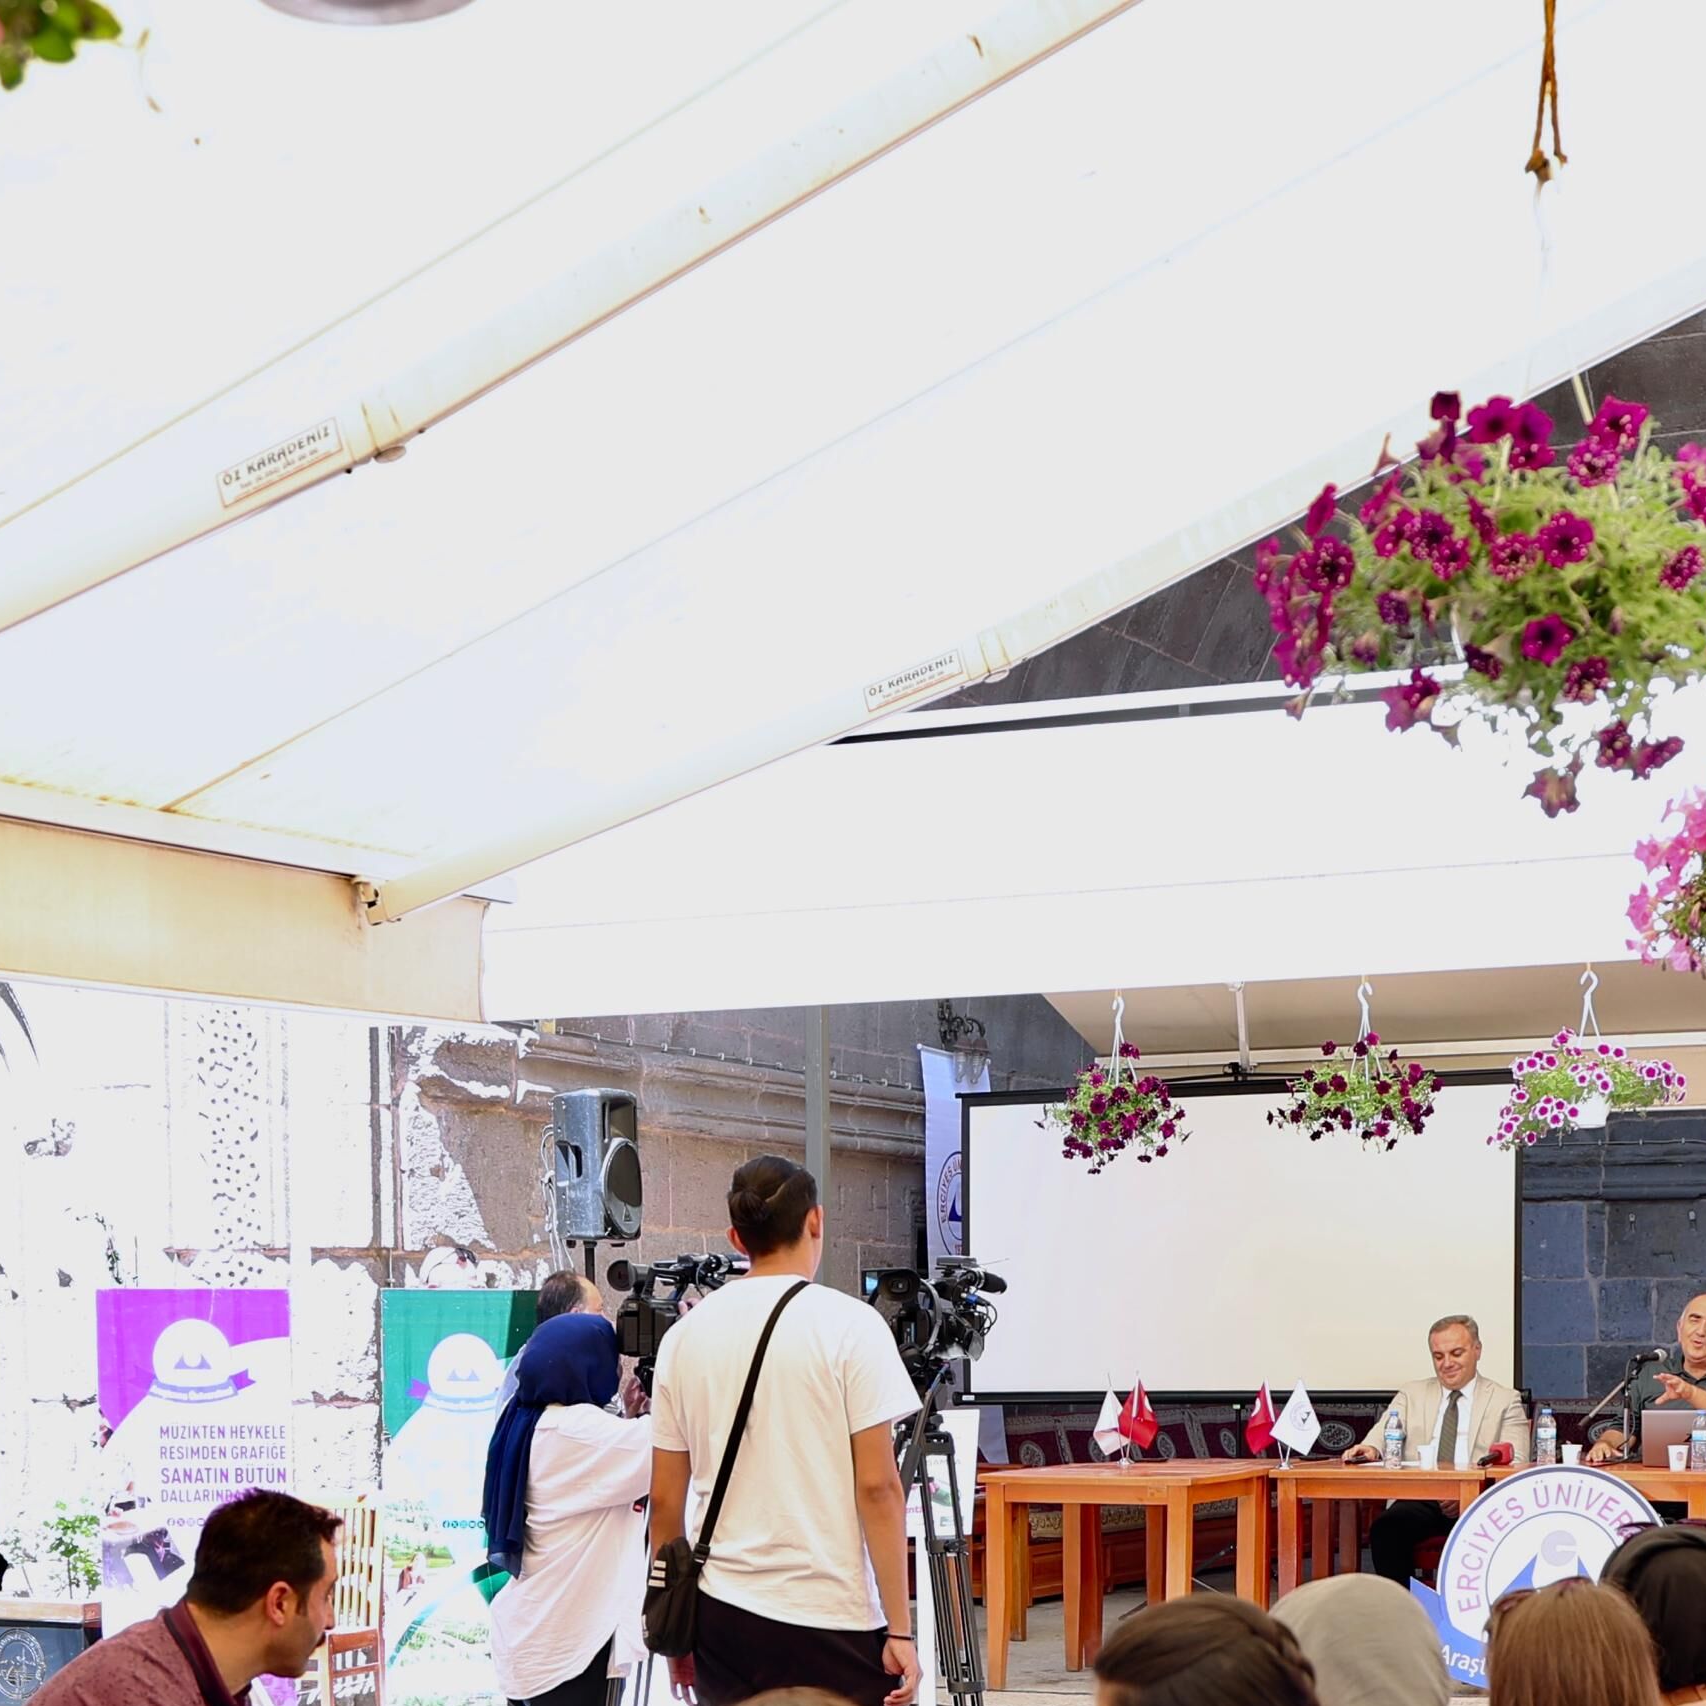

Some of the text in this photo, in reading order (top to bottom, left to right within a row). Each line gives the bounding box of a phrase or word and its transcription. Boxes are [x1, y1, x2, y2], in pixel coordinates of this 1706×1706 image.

[230, 1424, 286, 1439] HEYKELE
[160, 1463, 287, 1484] SANATIN BÜTÜN
[160, 1488, 240, 1503] DALLARIND
[1456, 1479, 1639, 1614] ERCİYES ÜNİVER
[1440, 1643, 1487, 1679] Araşt
